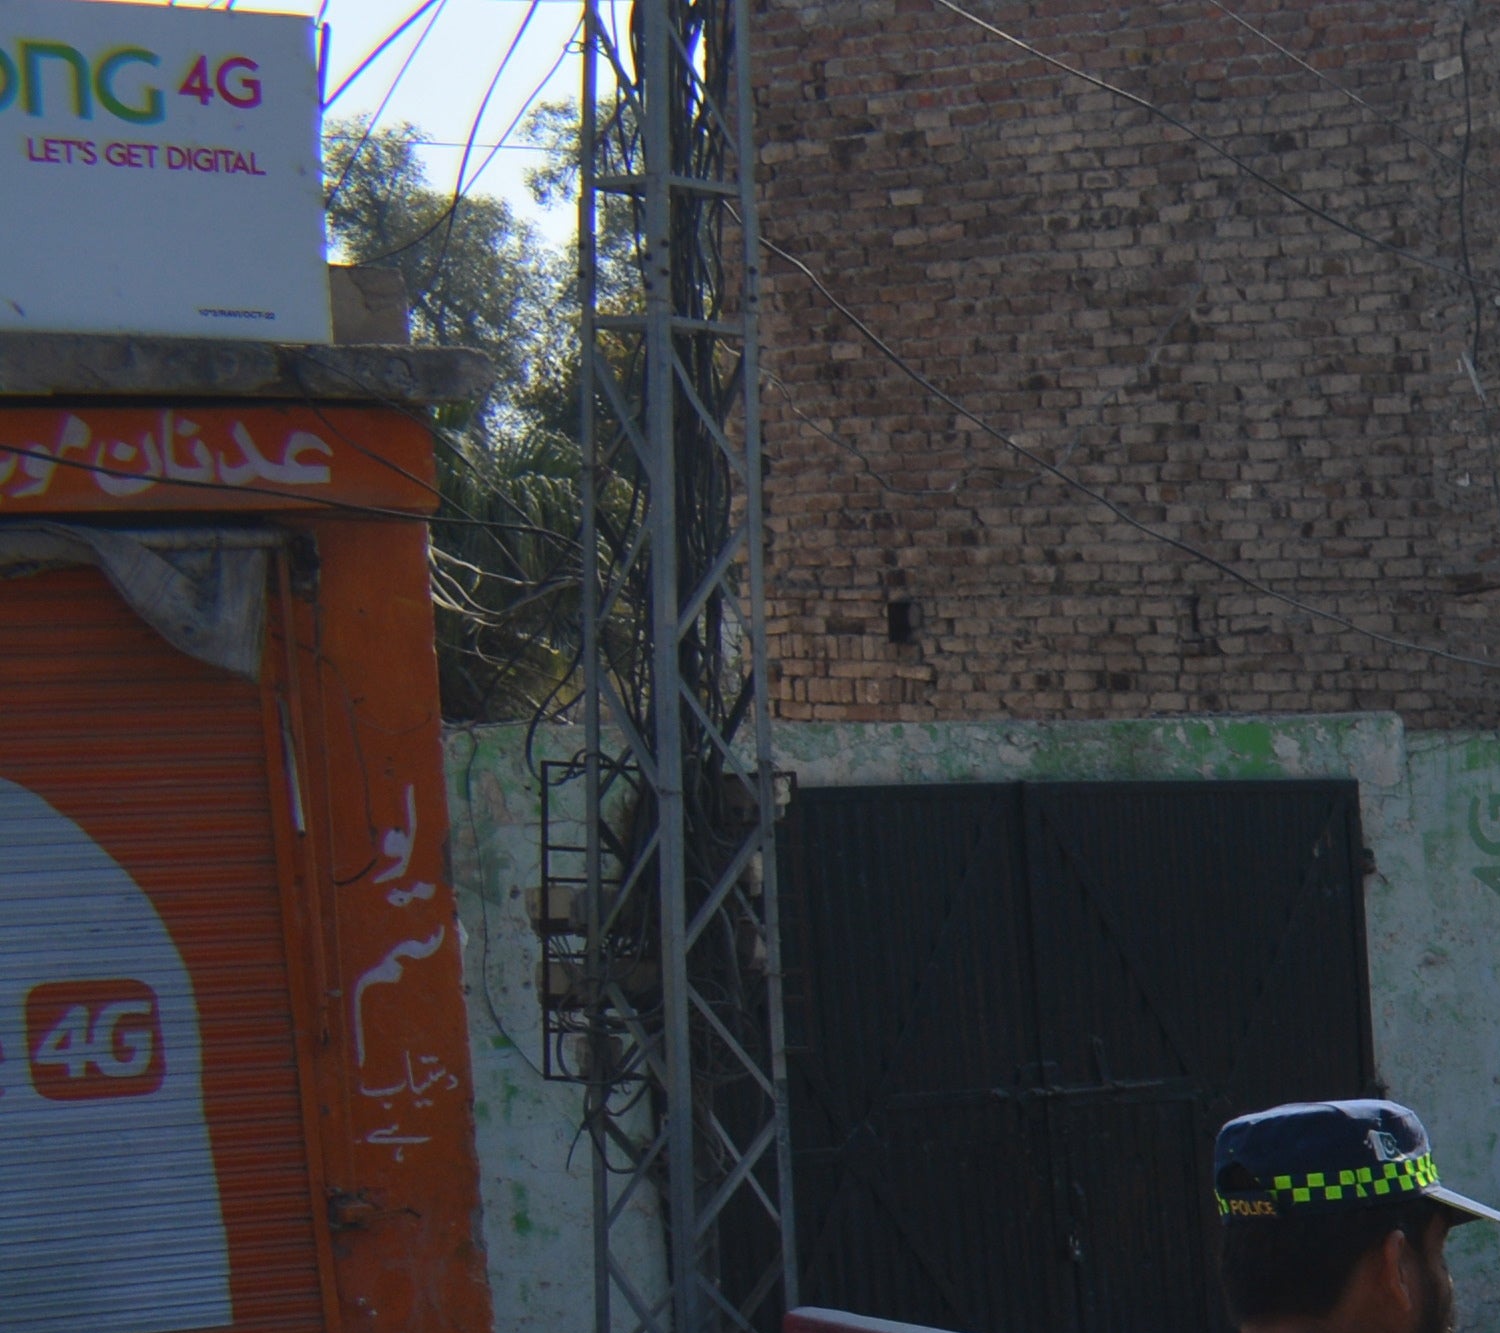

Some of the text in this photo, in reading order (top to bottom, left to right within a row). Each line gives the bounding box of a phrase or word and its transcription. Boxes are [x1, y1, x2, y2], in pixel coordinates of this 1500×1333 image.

[178, 55, 262, 109] 4G
[27, 137, 266, 176] LET'S GET DIGITAL
[95, 410, 332, 497] عدنان
[34, 1001, 152, 1079] 4G
[359, 1050, 459, 1109] دستیاب
[1229, 1199, 1278, 1216] POLICE
